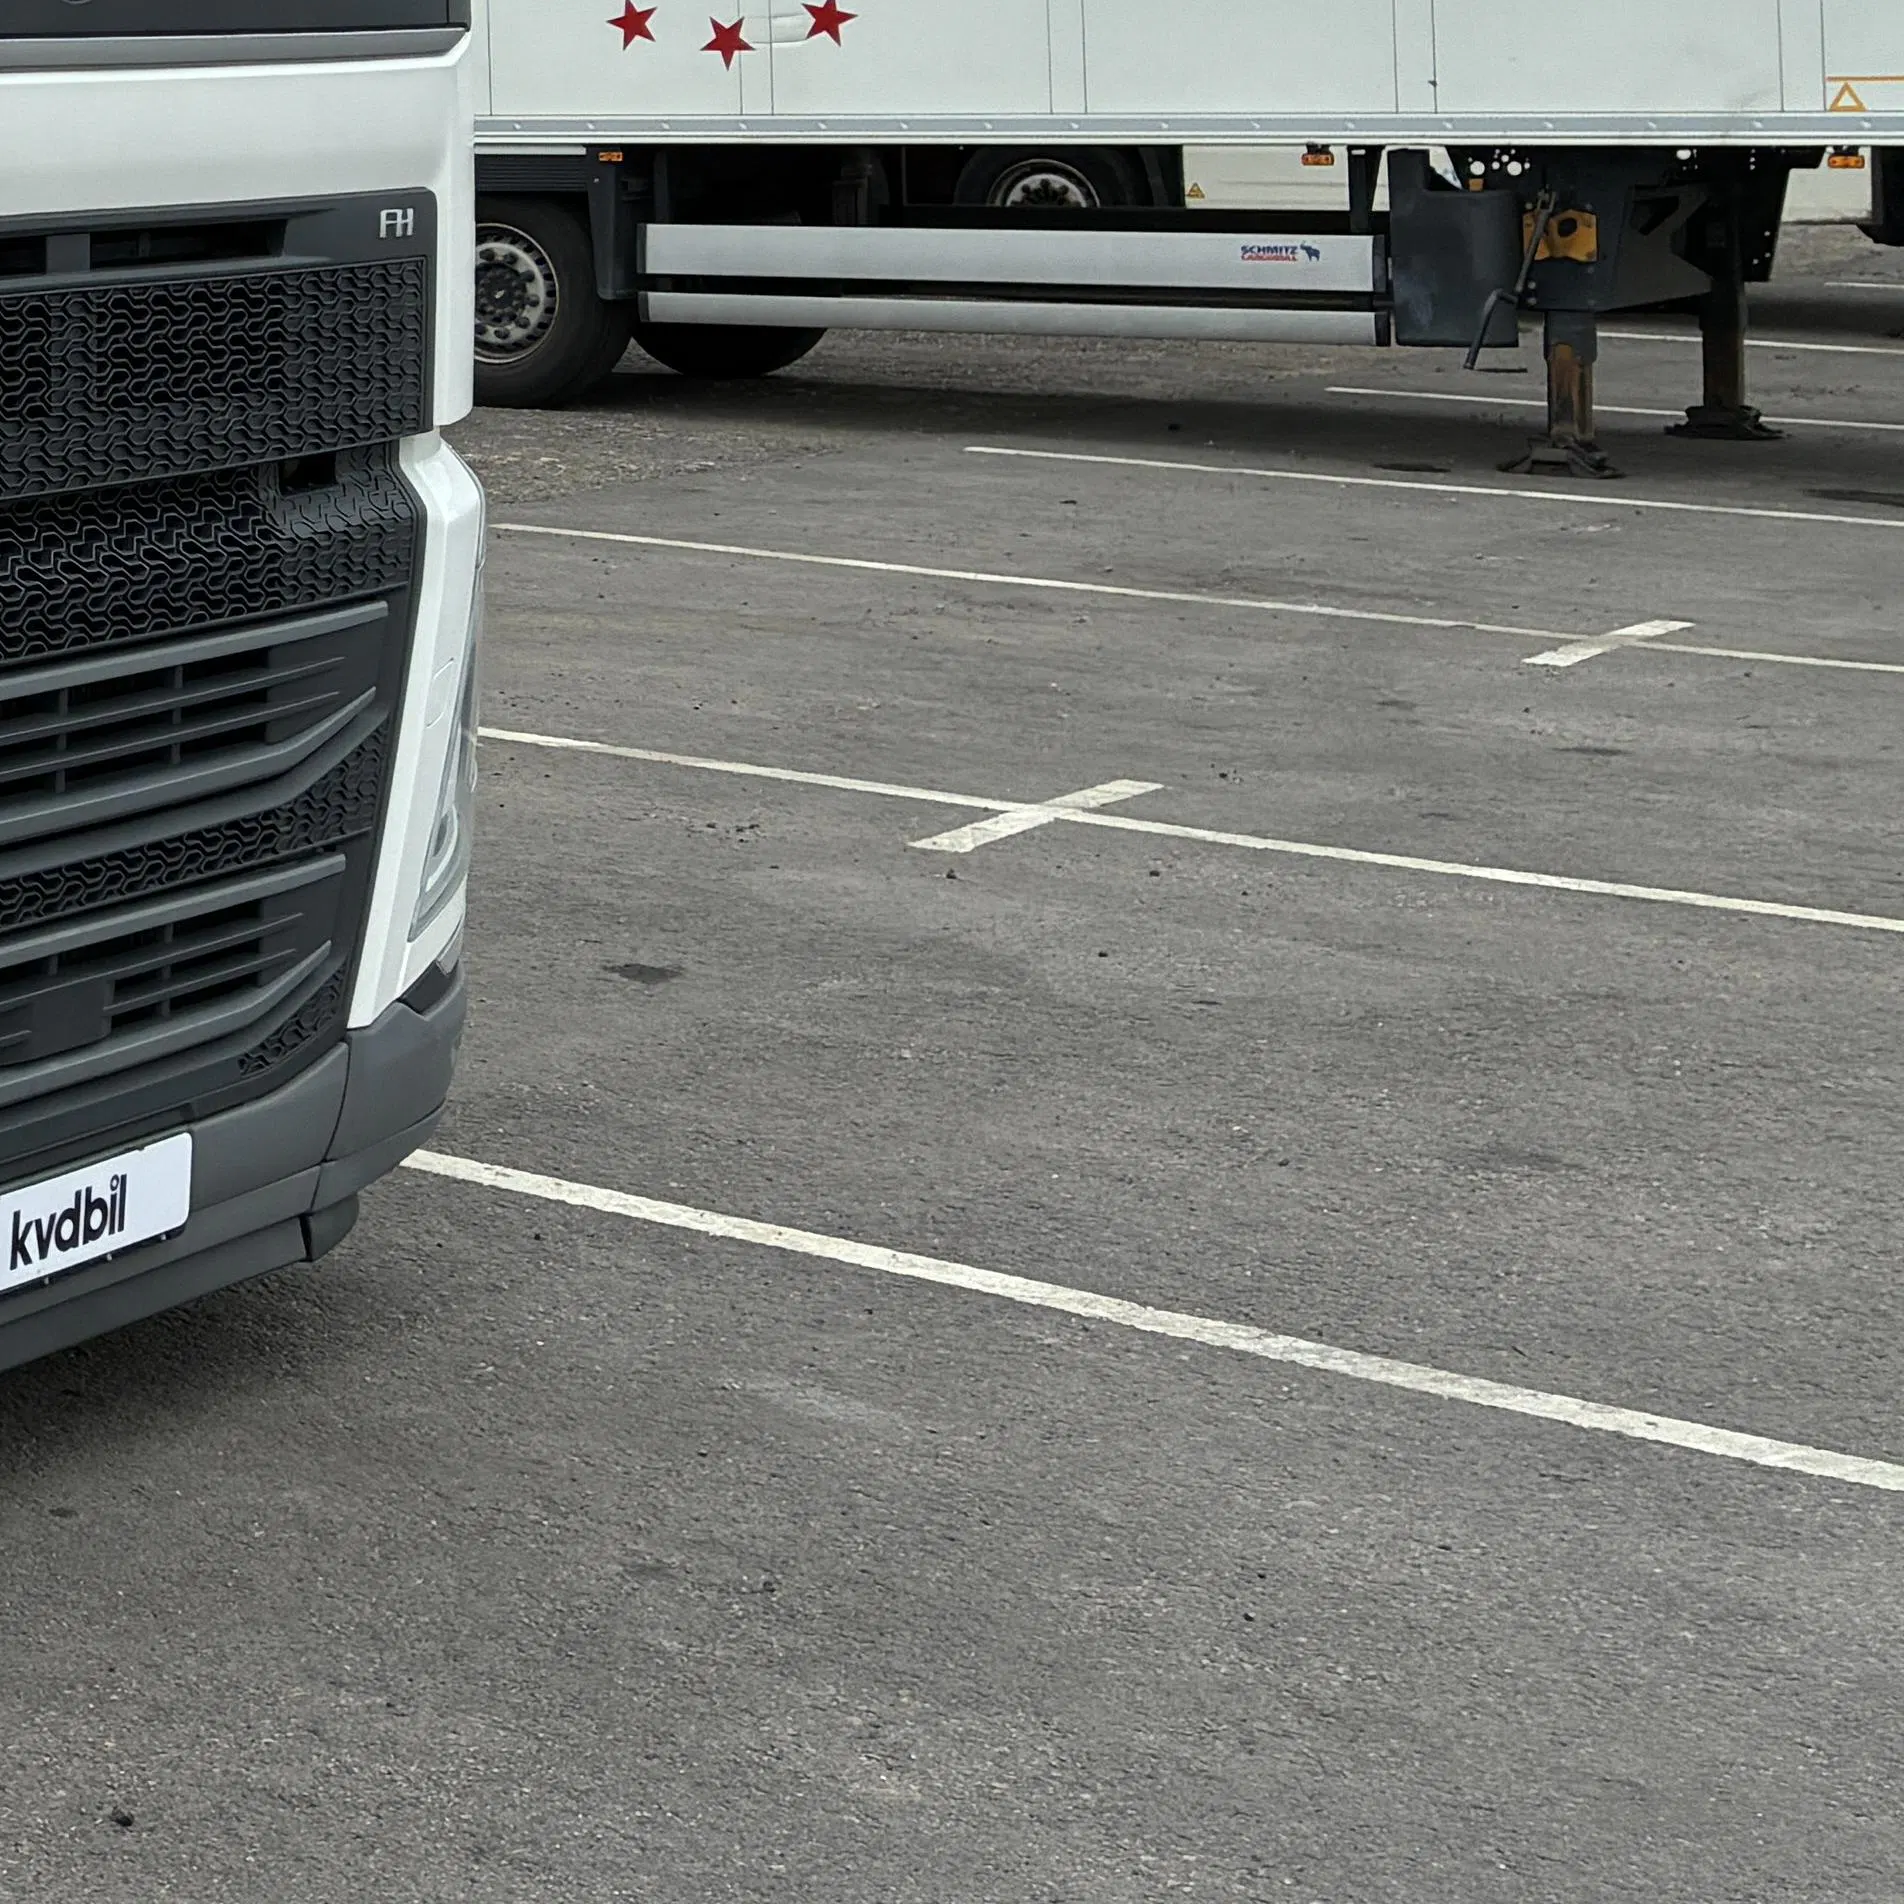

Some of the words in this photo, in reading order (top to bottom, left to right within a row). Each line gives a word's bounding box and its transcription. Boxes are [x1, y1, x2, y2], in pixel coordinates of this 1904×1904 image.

[379, 208, 414, 238] FH
[1240, 245, 1298, 255] SCHMITZ
[8, 1173, 129, 1272] kvdbil
